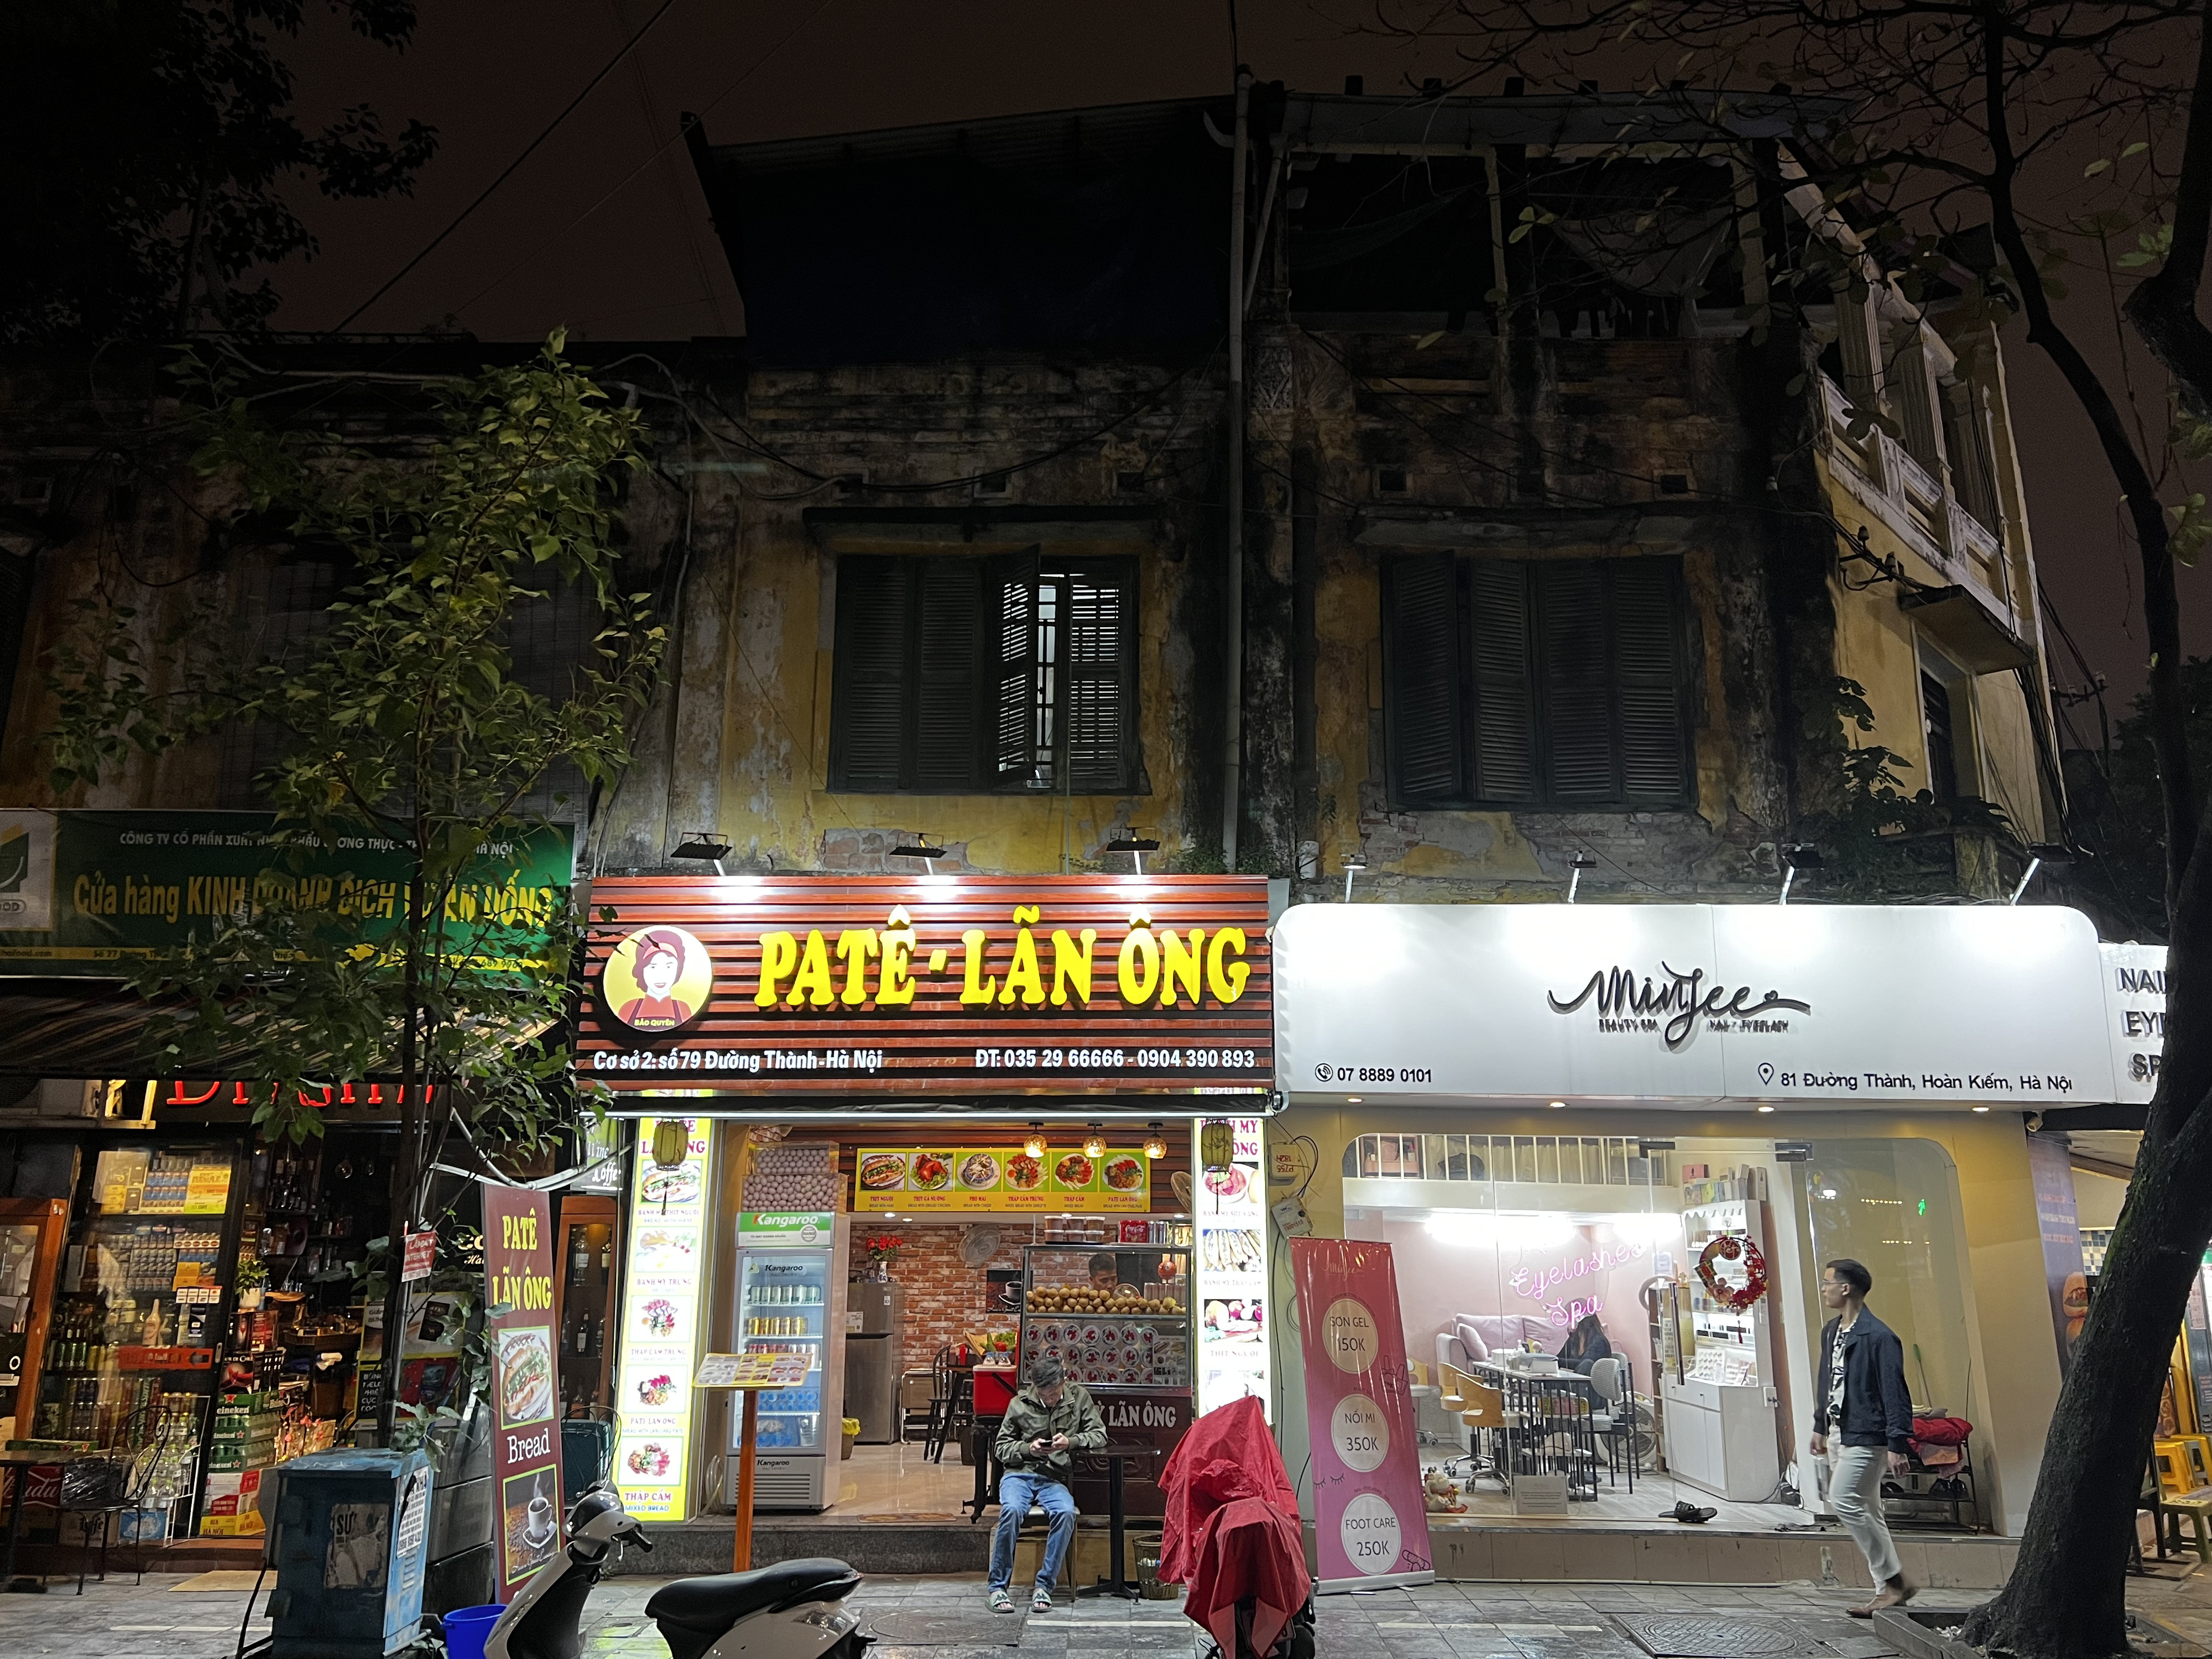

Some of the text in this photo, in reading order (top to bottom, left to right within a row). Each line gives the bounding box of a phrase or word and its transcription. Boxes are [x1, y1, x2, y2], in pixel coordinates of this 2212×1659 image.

[119, 831, 153, 844] CÔNG
[157, 833, 169, 844] TY
[192, 830, 222, 845] PHẦN
[491, 841, 513, 859] NỘI
[74, 870, 117, 914] Cửa
[124, 874, 180, 924] hàng
[187, 876, 247, 915] KINH
[754, 905, 916, 1007] PATÊ
[959, 905, 1097, 1005] LÃN
[1118, 903, 1250, 1005] ÔNG
[594, 1051, 617, 1070] Cơ
[620, 1048, 640, 1070] sở
[659, 1047, 678, 1070] số
[680, 1051, 701, 1070] 79
[705, 1048, 760, 1073] Đường
[854, 1050, 883, 1073] Nội
[975, 1049, 1001, 1068] ĐT:
[1004, 1049, 1036, 1068] 035
[1042, 1049, 1063, 1068] 29
[1068, 1049, 1124, 1068] 66666
[1138, 1050, 1181, 1068] 0904
[1186, 1050, 1218, 1068] 390
[1222, 1050, 1255, 1068] 893
[1337, 1068, 1432, 1083] 07 8889 0101
[1781, 1071, 2072, 1093] 81 Đường Thành, Hoàn Kiếm, Hà Nội
[502, 1207, 538, 1250] PATÊ
[753, 1213, 818, 1228] Kangaroo
[1512, 1240, 1646, 1300] Eyelashes
[493, 1266, 552, 1310] LÃN ÔNG
[1548, 1295, 1603, 1330] Spa
[1330, 1316, 1369, 1328] SƠN GEL
[1337, 1337, 1366, 1352] 150K
[216, 1406, 250, 1415] eineken
[1108, 1400, 1177, 1428] LÃN ÔNG
[1344, 1408, 1375, 1424] NỐI MI
[507, 1428, 551, 1464] Bread
[1346, 1437, 1379, 1451] 350K
[1345, 1517, 1396, 1530] FOOT CARE
[1357, 1541, 1390, 1556] 250K
